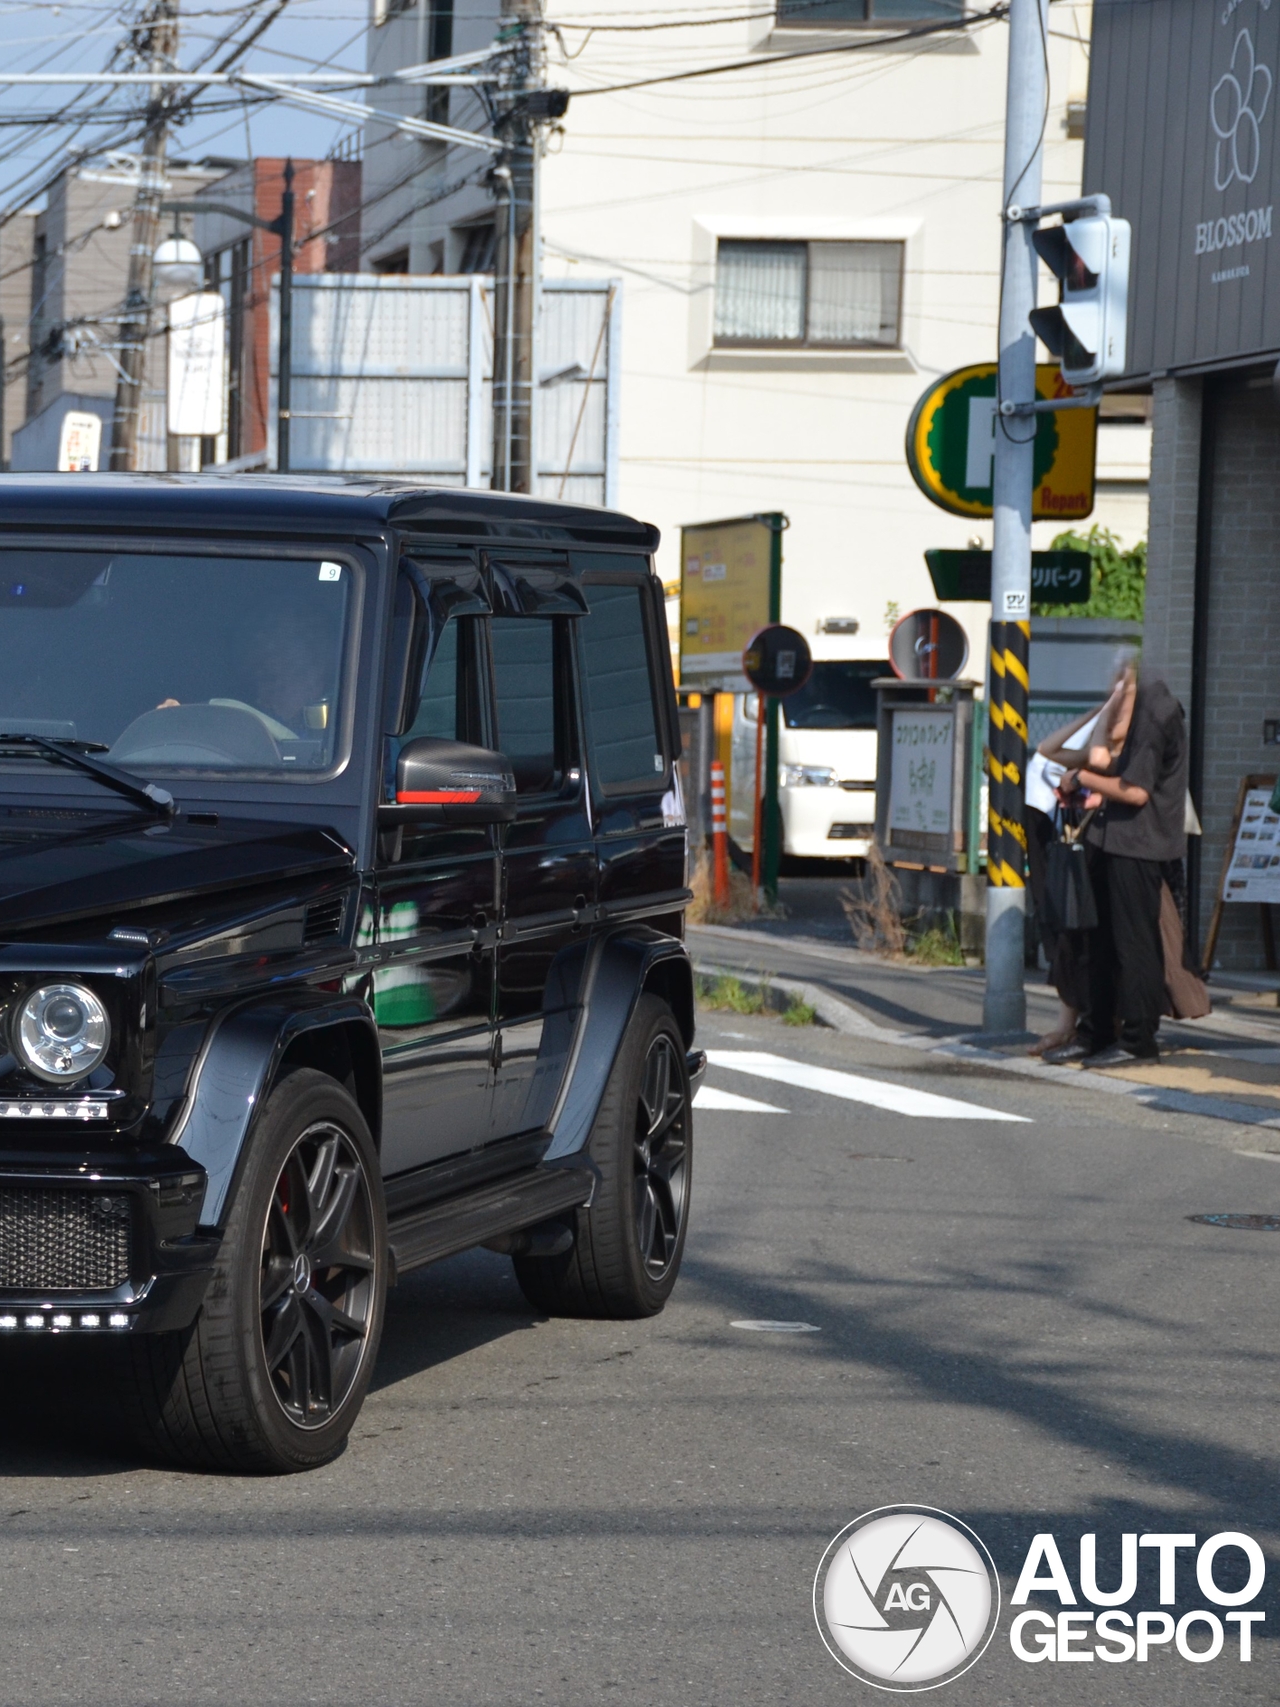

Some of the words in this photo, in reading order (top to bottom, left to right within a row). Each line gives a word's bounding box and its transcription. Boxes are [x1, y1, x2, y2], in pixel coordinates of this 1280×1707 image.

[1195, 205, 1273, 255] BLOSSOM
[1041, 486, 1088, 512] Repark
[329, 568, 337, 579] 9
[1032, 567, 1083, 588] リパーク
